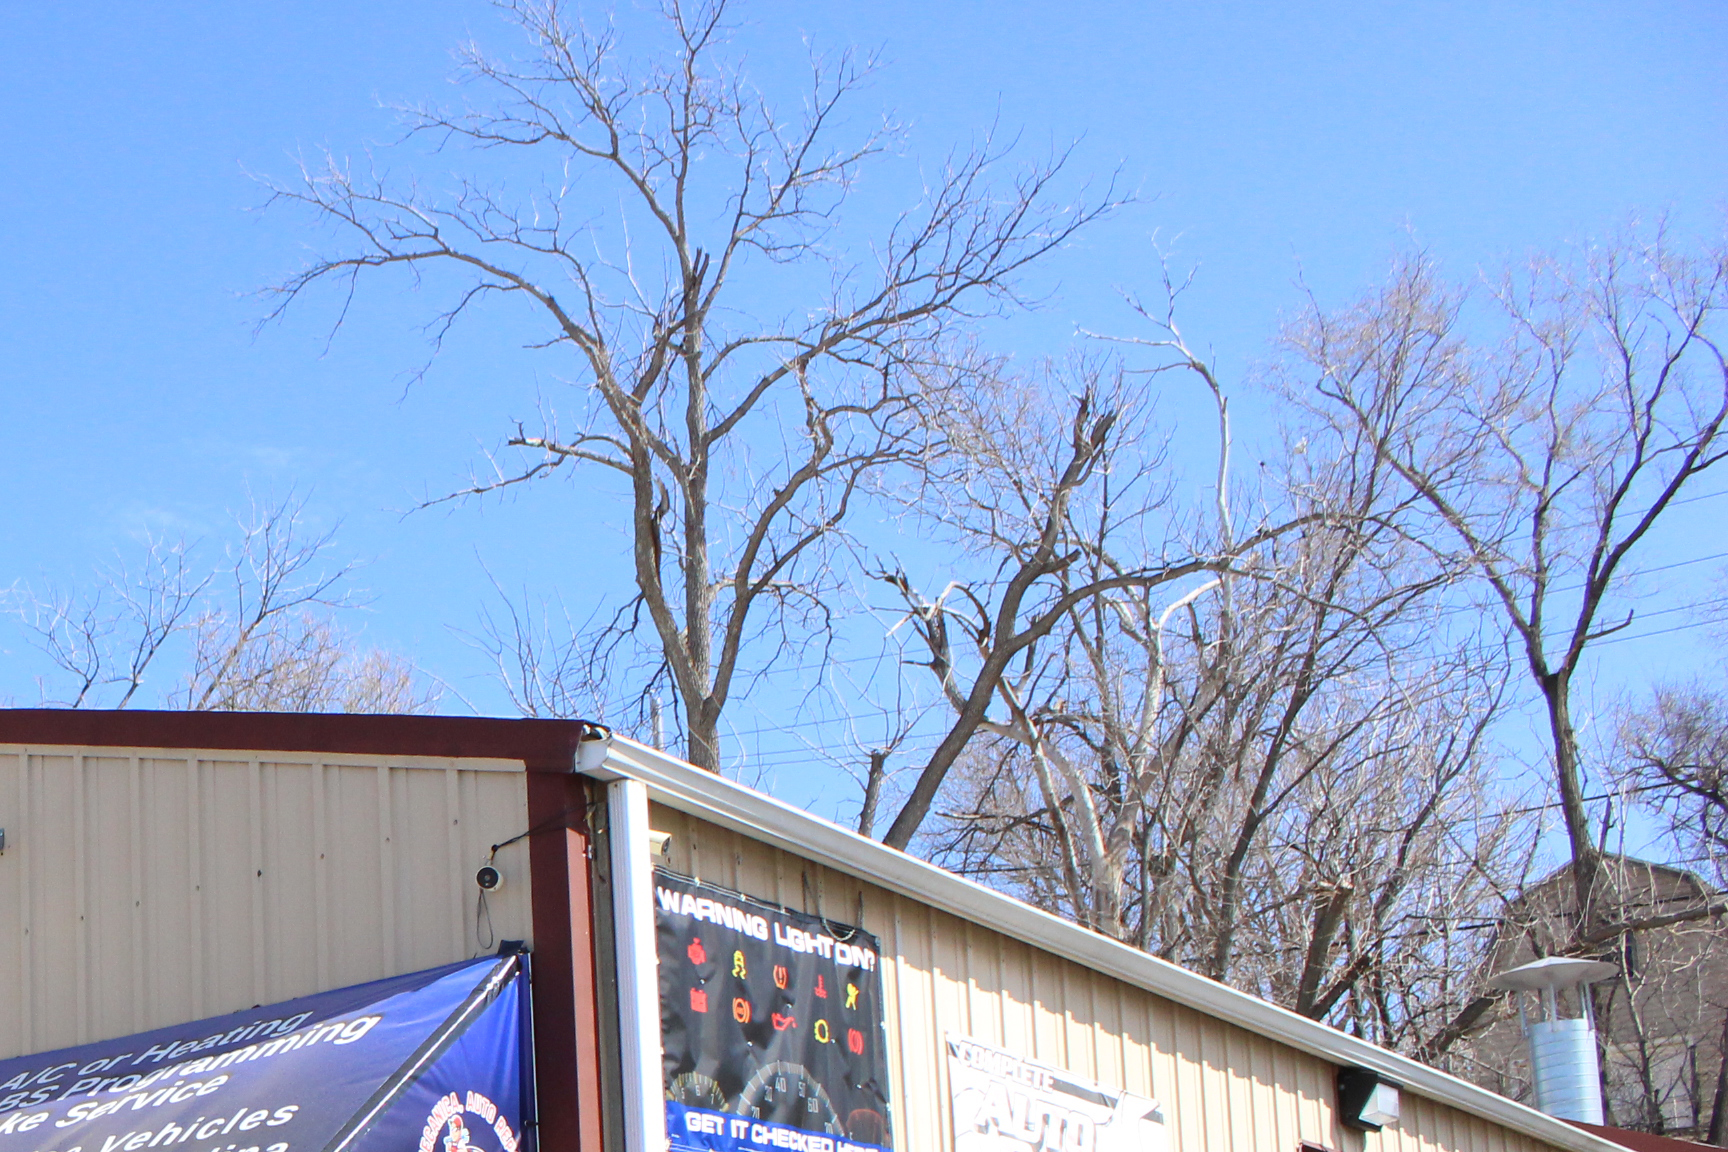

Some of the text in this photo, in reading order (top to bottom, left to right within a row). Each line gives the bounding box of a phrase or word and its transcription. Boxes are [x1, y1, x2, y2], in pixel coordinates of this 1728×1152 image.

[656, 886, 876, 971] WARNING LIGHT ON?
[1, 1010, 314, 1091] A/C or Heating
[58, 1014, 382, 1101] Programming
[959, 1040, 1055, 1094] COMPLETE
[56, 1075, 231, 1128] Service
[465, 1089, 498, 1124] AUTO
[695, 1085, 701, 1097] 6
[774, 1076, 788, 1094] 40
[807, 1097, 819, 1114] 60
[685, 1111, 725, 1136] GET
[730, 1118, 750, 1140] IT
